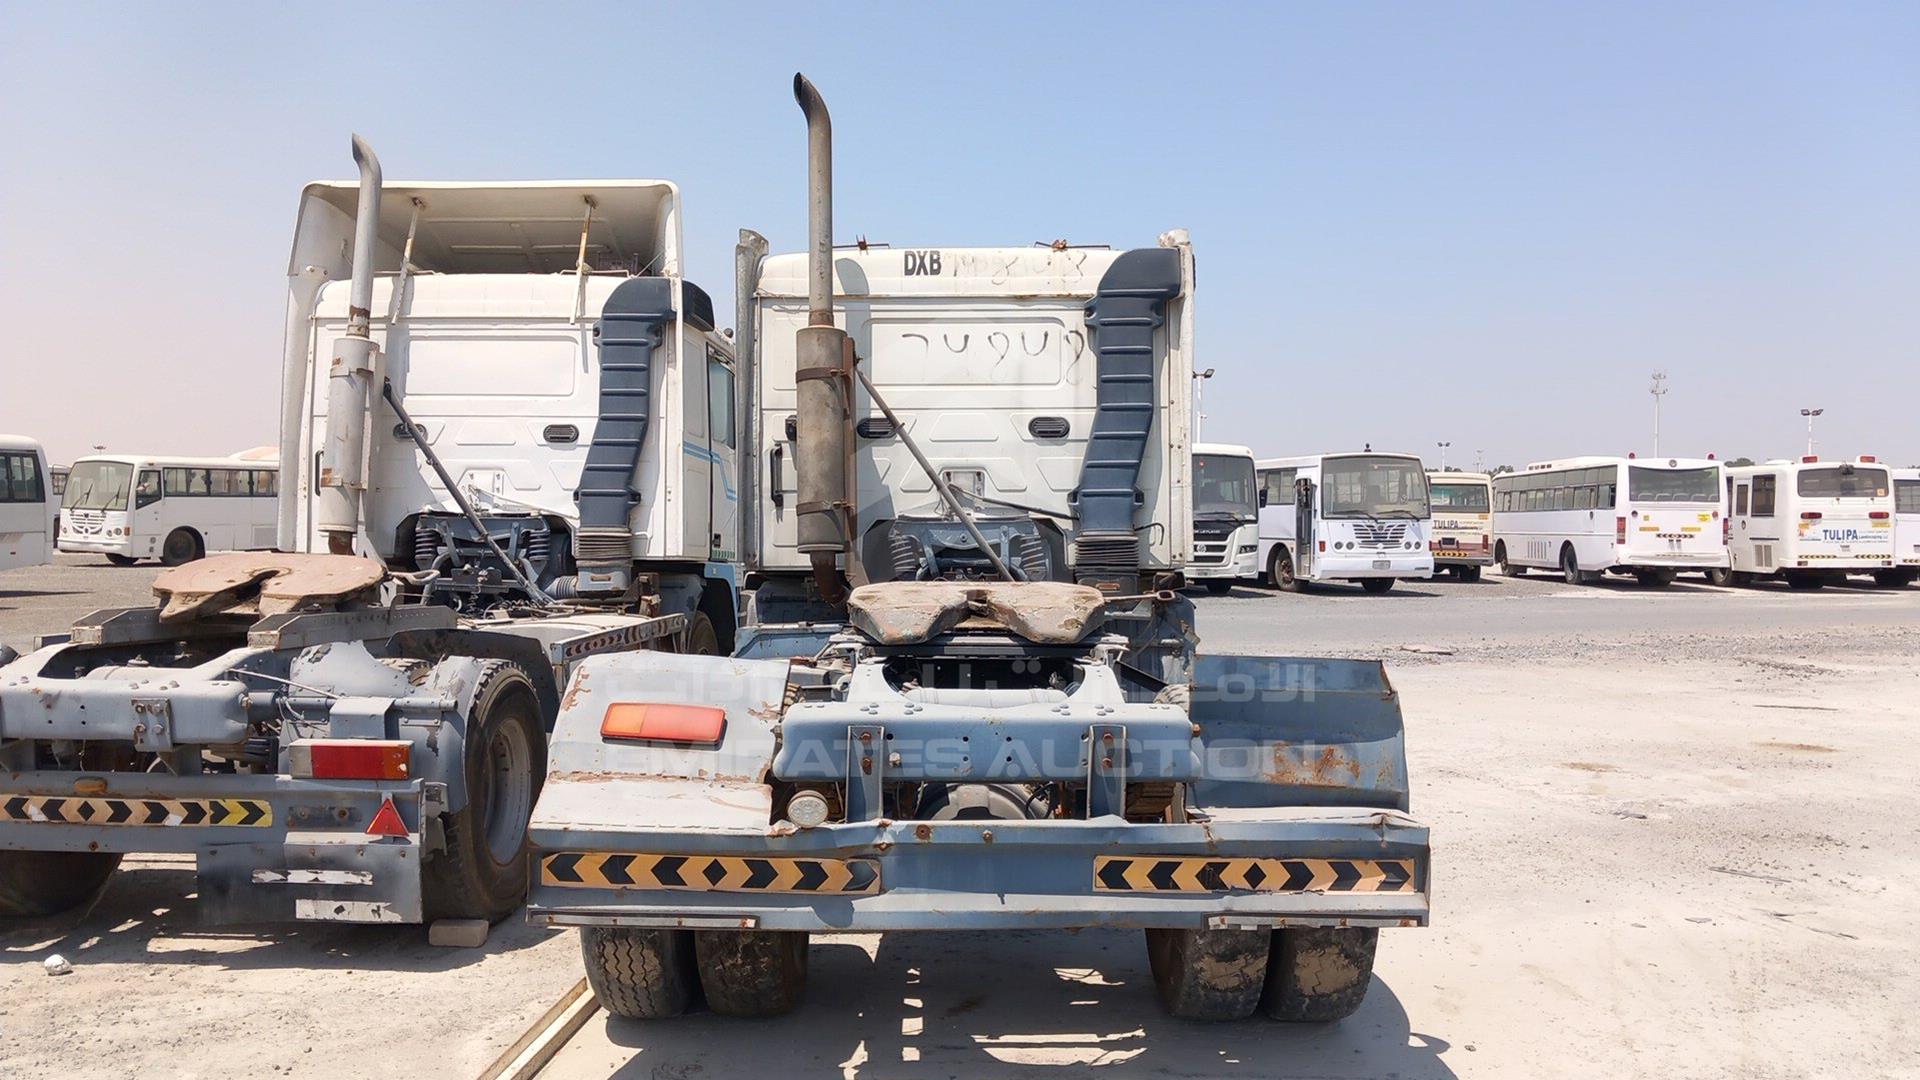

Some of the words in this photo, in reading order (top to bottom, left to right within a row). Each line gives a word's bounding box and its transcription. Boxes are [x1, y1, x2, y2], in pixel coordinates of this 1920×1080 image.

[904, 250, 941, 277] DXB
[1433, 520, 1459, 529] TULIPA
[1823, 529, 1858, 540] TULIPA
